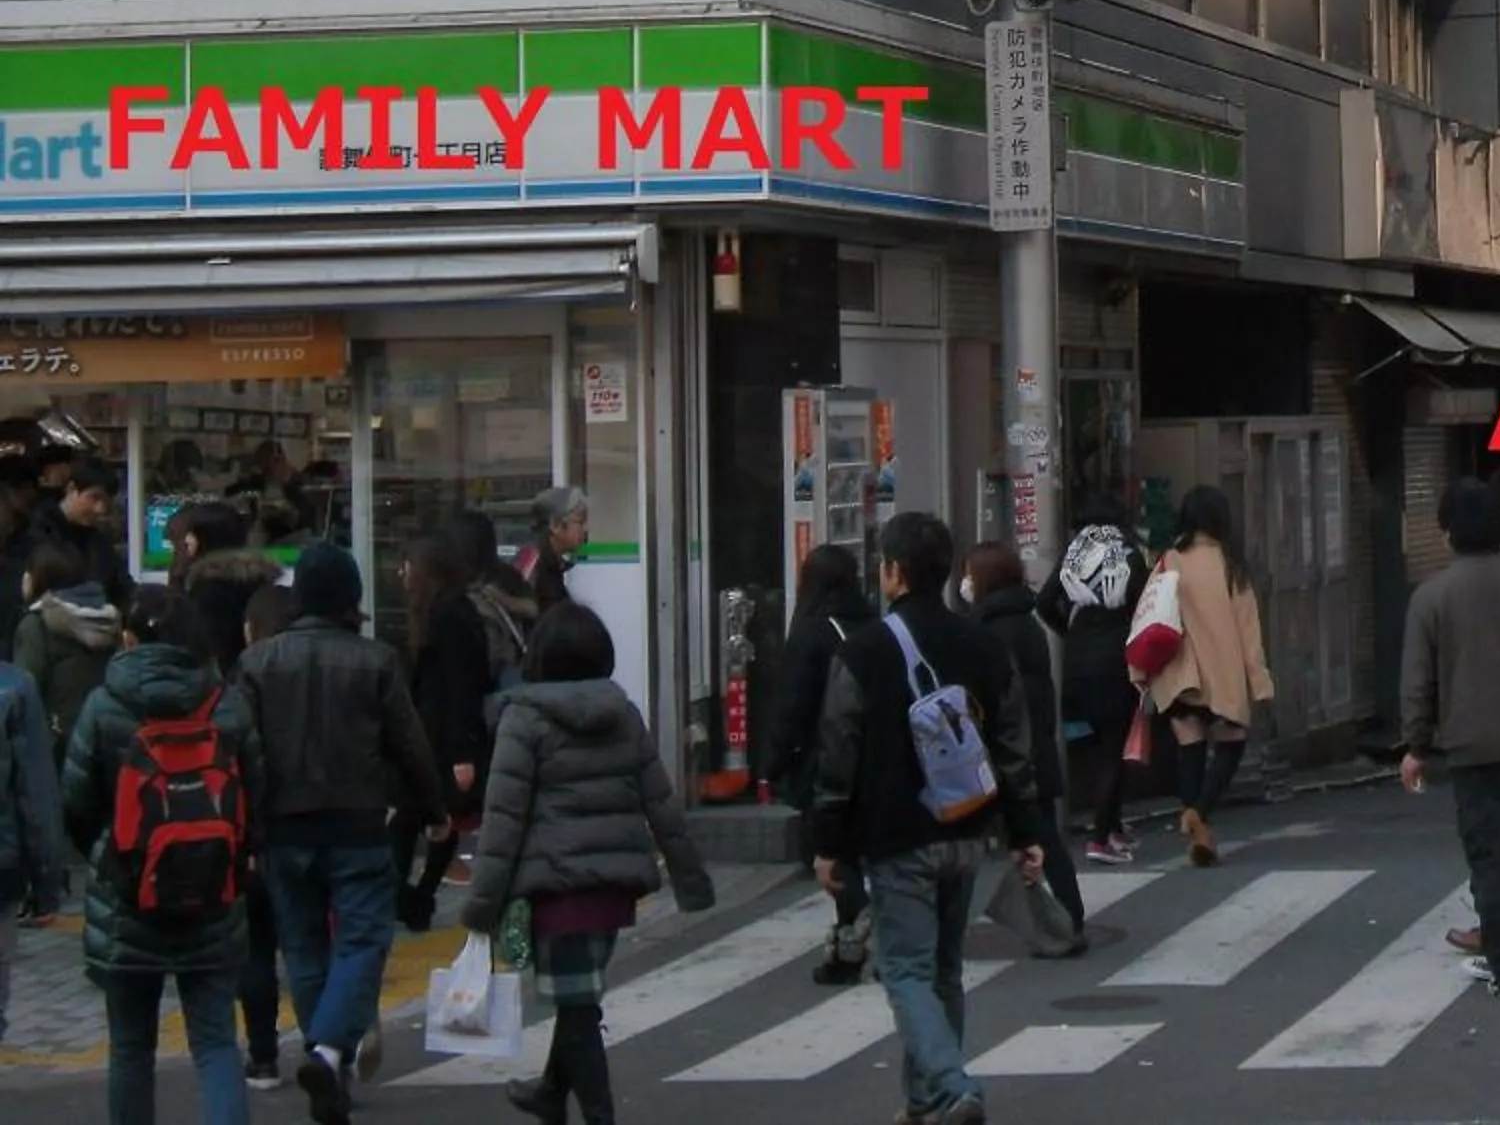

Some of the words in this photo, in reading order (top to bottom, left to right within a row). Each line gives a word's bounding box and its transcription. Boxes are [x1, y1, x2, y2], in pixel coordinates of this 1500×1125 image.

[0, 122, 102, 180] art
[1007, 29, 1030, 200] 防犯カメラ作動中
